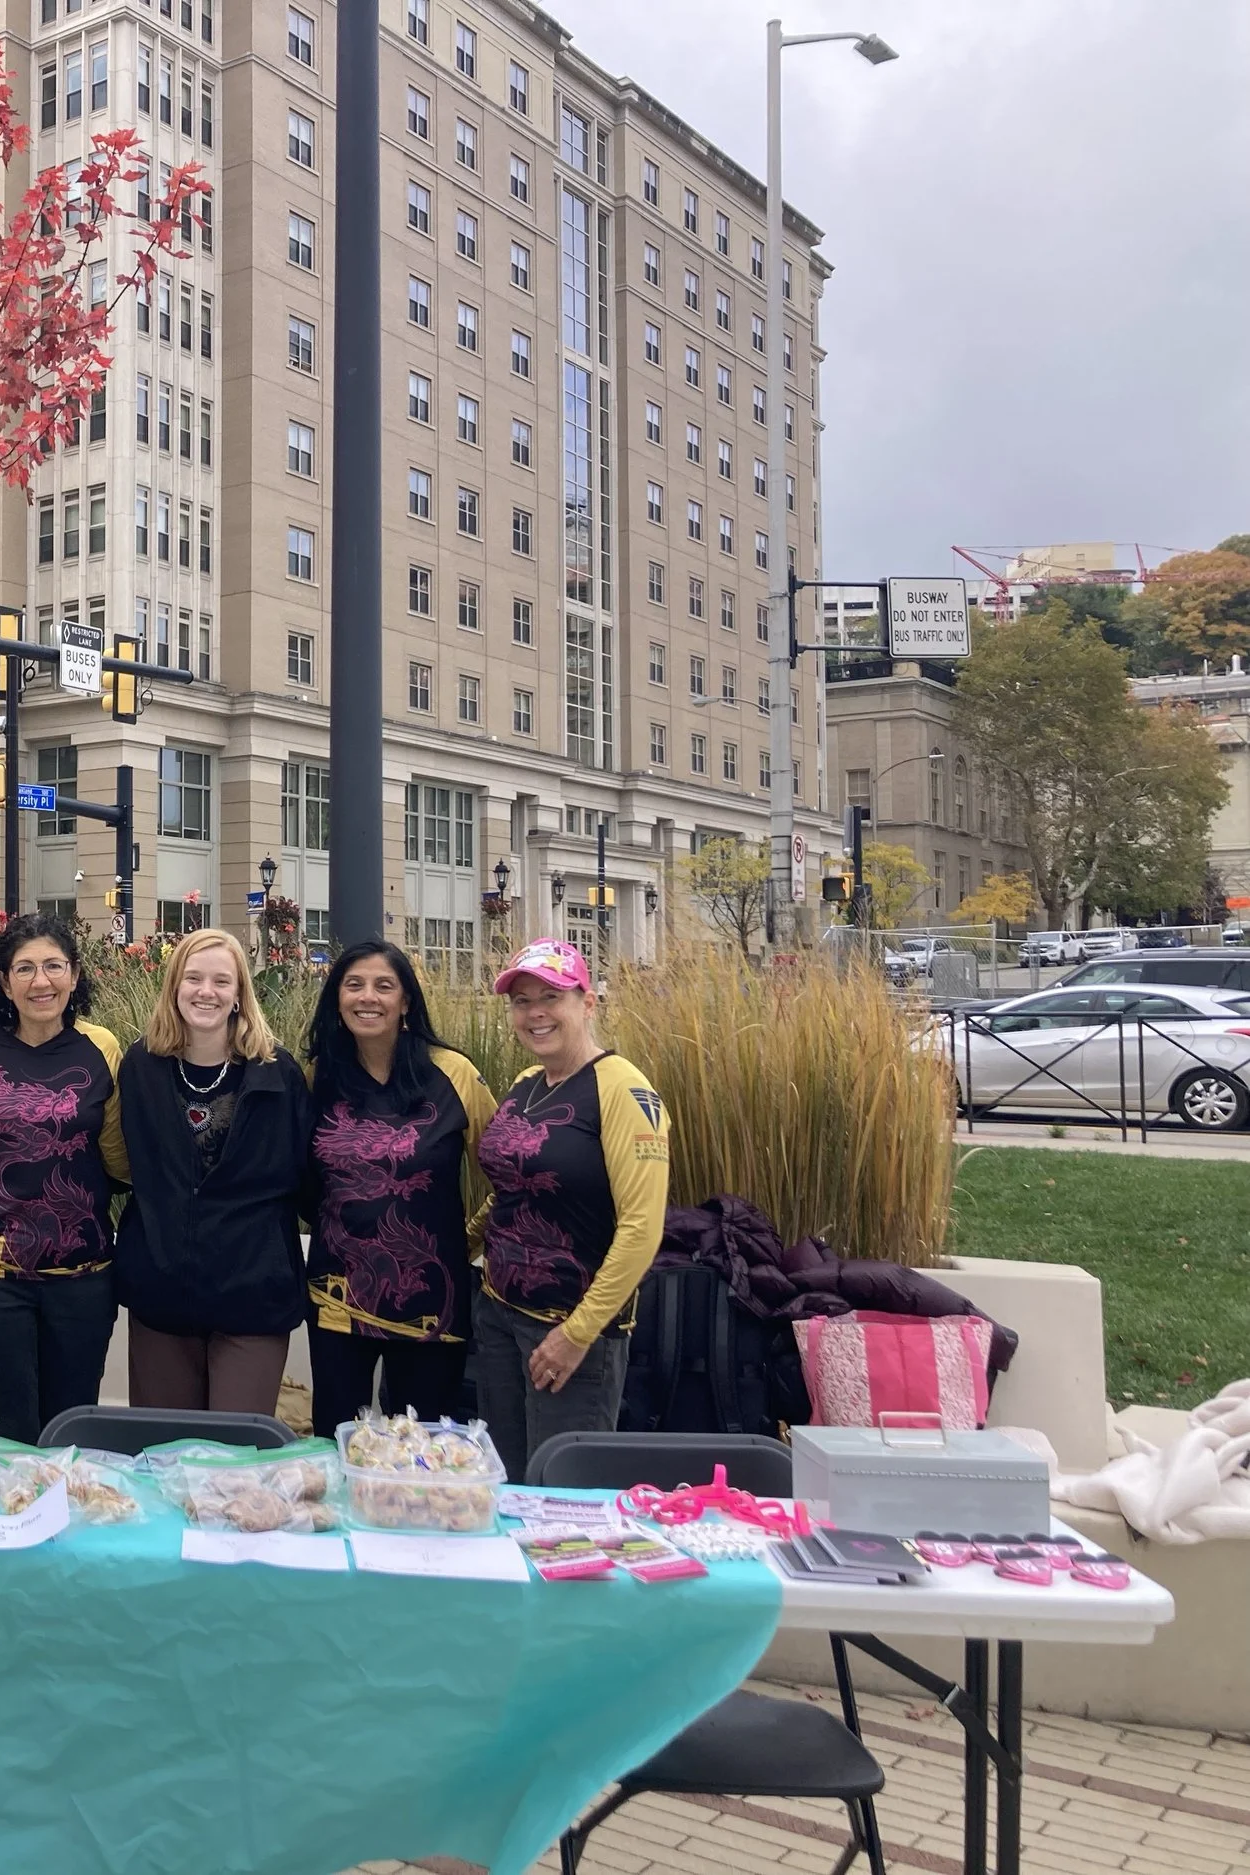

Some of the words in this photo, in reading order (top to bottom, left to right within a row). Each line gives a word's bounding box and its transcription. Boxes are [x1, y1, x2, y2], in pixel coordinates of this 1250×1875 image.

[907, 592, 949, 604] BUSWAY
[893, 610, 906, 622] DO
[911, 610, 929, 622] NOT
[933, 611, 964, 622] ENTER
[71, 626, 100, 639] RESTRICTED
[894, 630, 910, 642] BUS
[913, 630, 943, 642] TRAFFIC
[946, 630, 965, 642] ONLY
[78, 638, 93, 647] LANE
[66, 650, 96, 667] BUSES
[68, 669, 93, 684] ONLY
